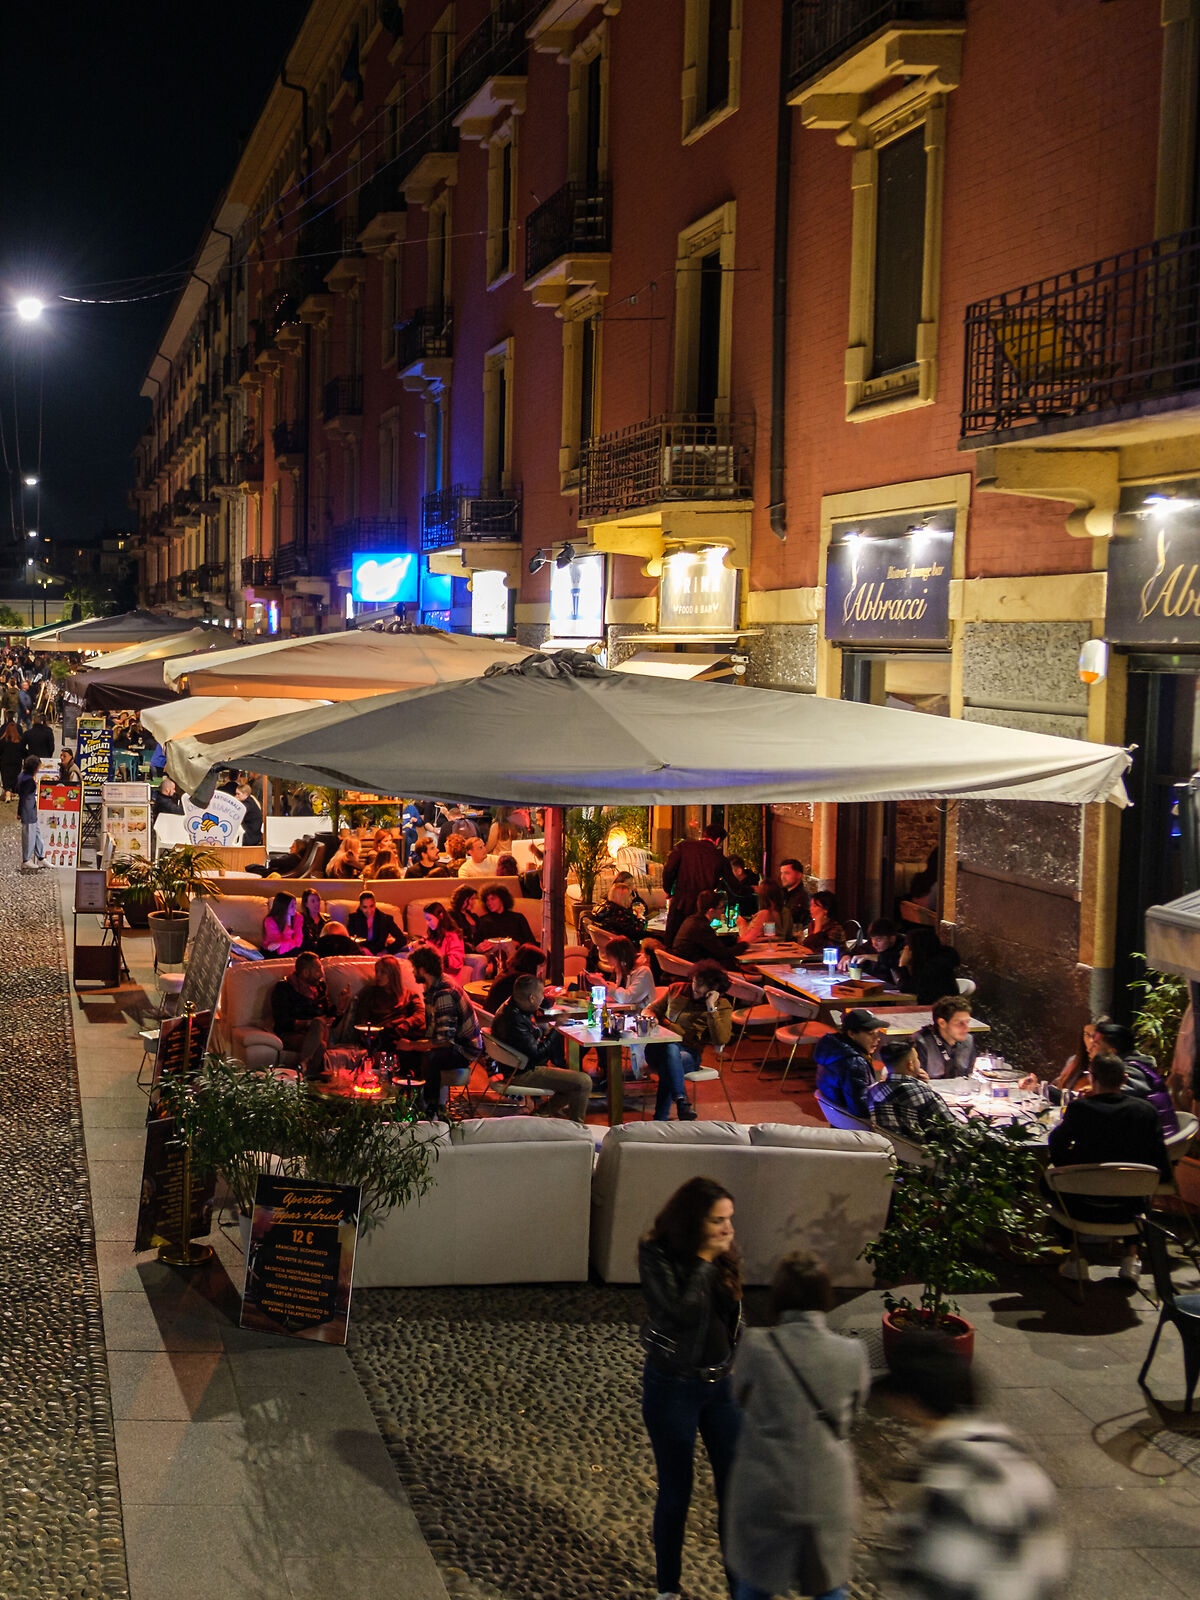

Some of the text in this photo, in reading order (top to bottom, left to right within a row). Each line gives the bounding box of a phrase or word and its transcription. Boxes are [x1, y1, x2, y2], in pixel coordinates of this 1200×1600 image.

[845, 583, 928, 621] Abbracci
[679, 606, 693, 615] FOOD
[80, 756, 109, 772] BIRRA
[282, 1192, 334, 1208] Aperitivo
[292, 1229, 304, 1244] 12
